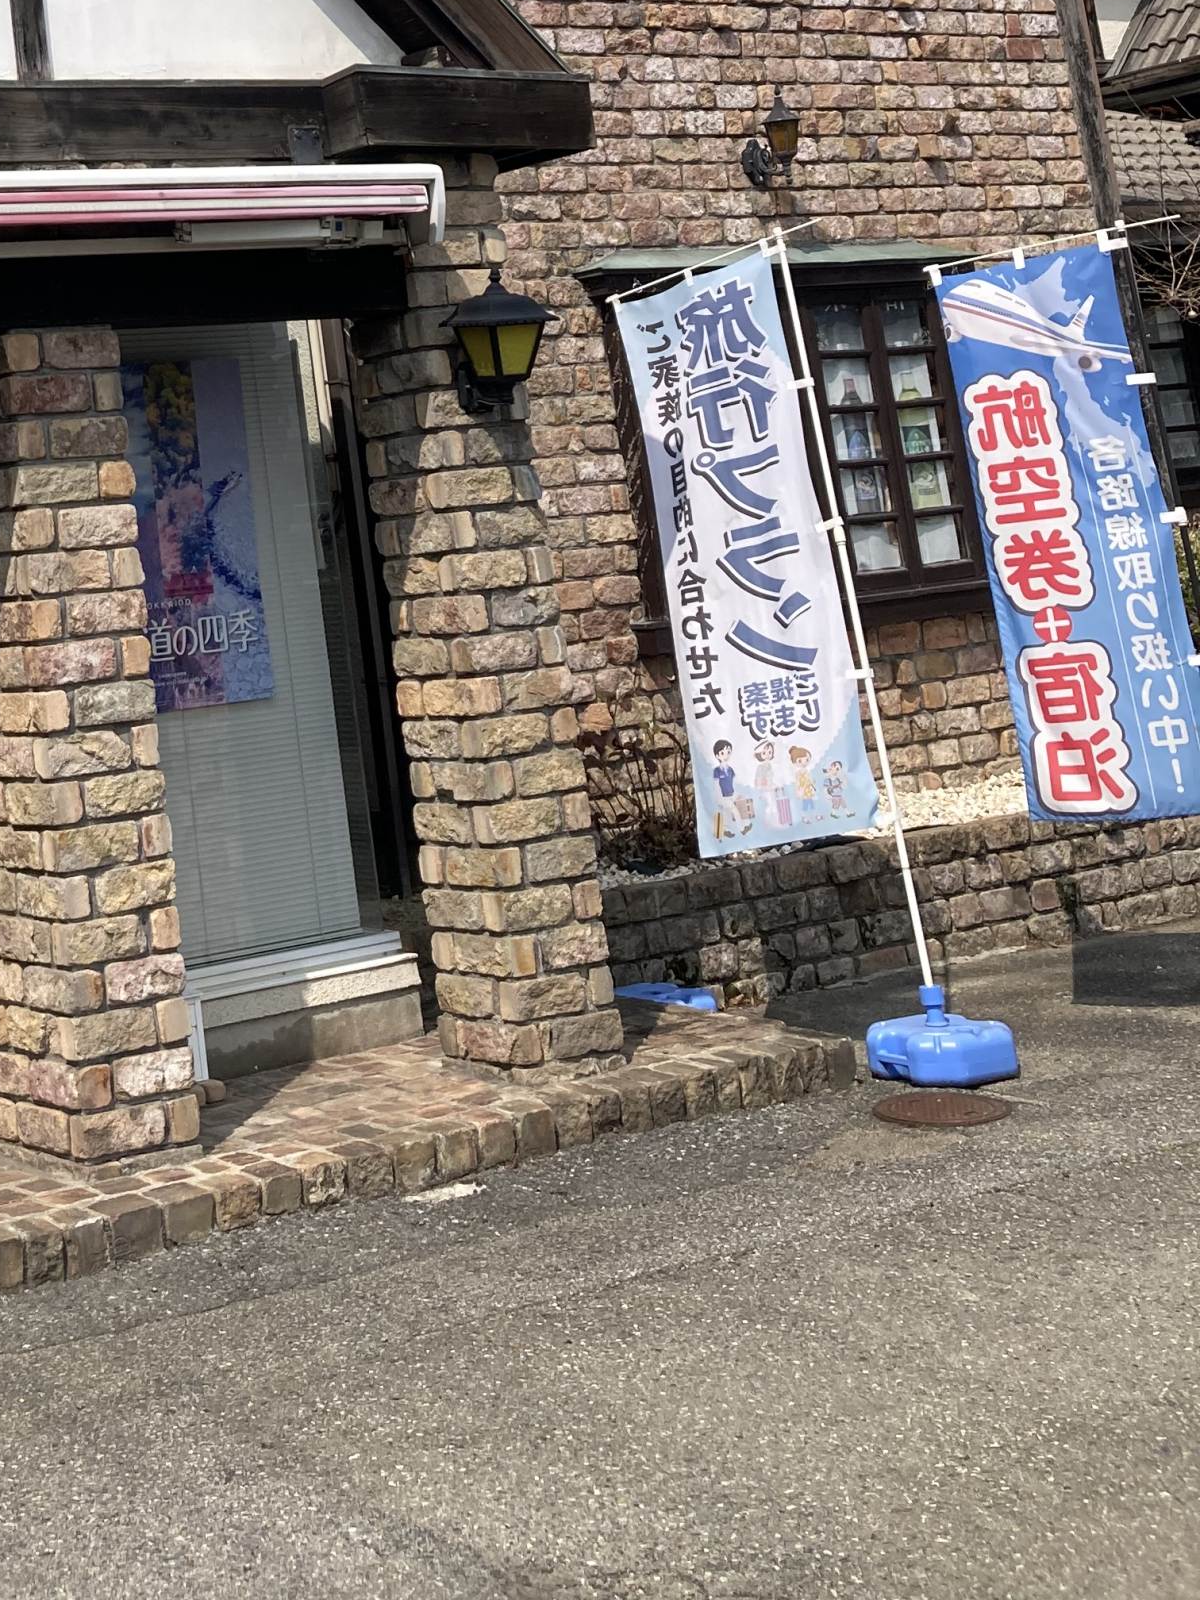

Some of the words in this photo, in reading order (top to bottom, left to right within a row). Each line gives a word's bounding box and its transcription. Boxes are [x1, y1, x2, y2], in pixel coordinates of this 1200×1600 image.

[145, 598, 192, 610] OKKAIDO
[142, 608, 259, 662] 道の四季
